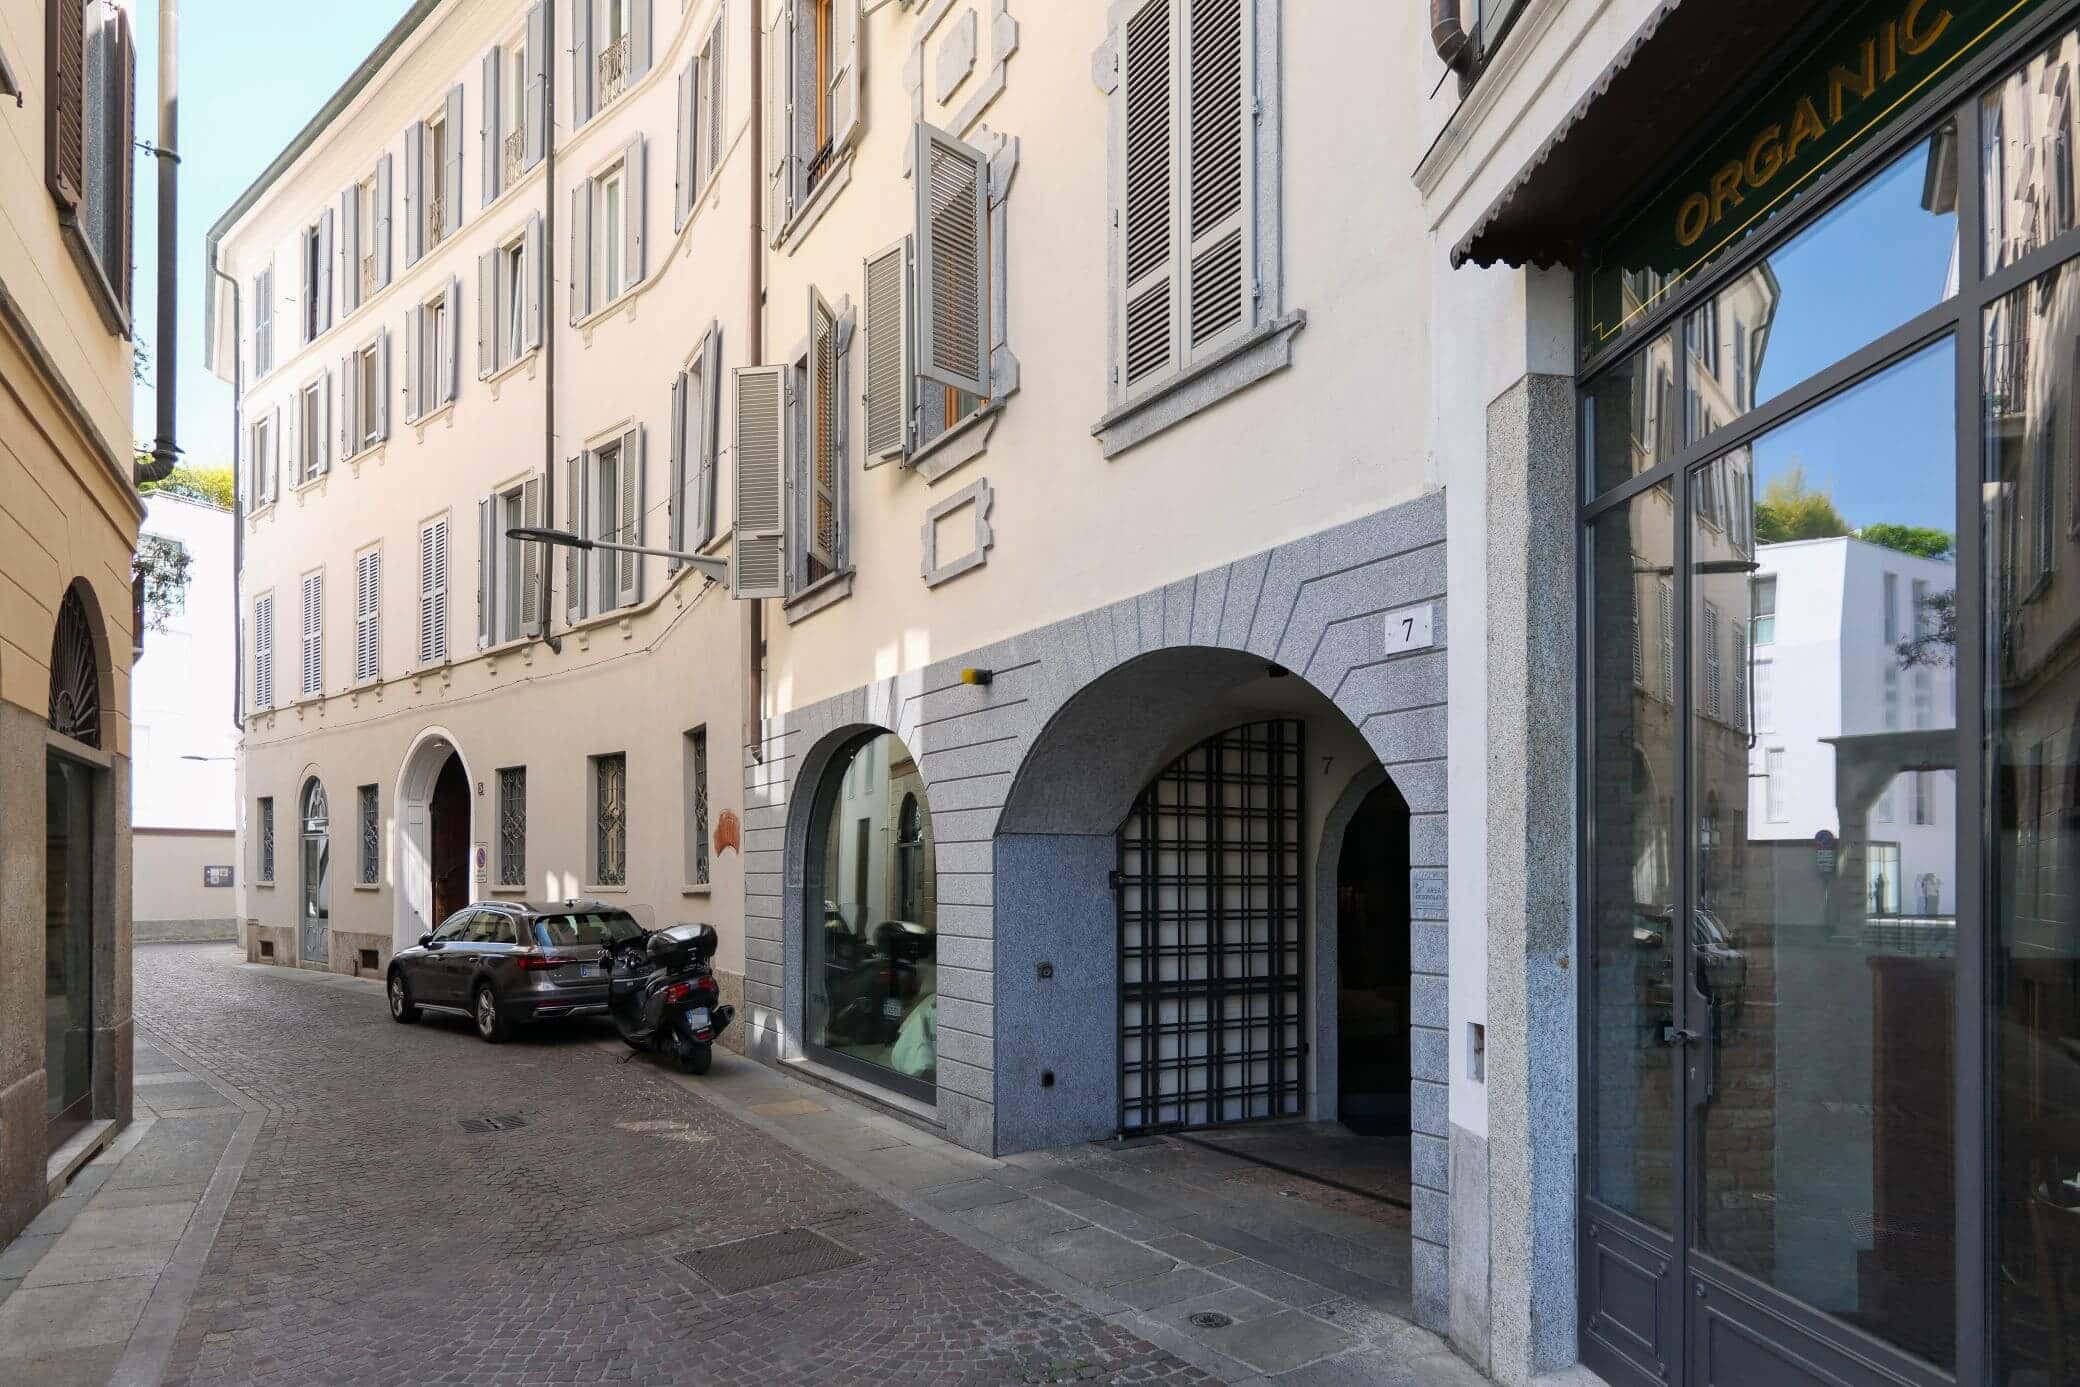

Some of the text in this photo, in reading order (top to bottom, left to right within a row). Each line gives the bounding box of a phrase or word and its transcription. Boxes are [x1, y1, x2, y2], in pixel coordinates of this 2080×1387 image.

[1675, 0, 1953, 247] ORGANIC
[1402, 618, 1413, 641] 7
[1321, 756, 1334, 775] 7
